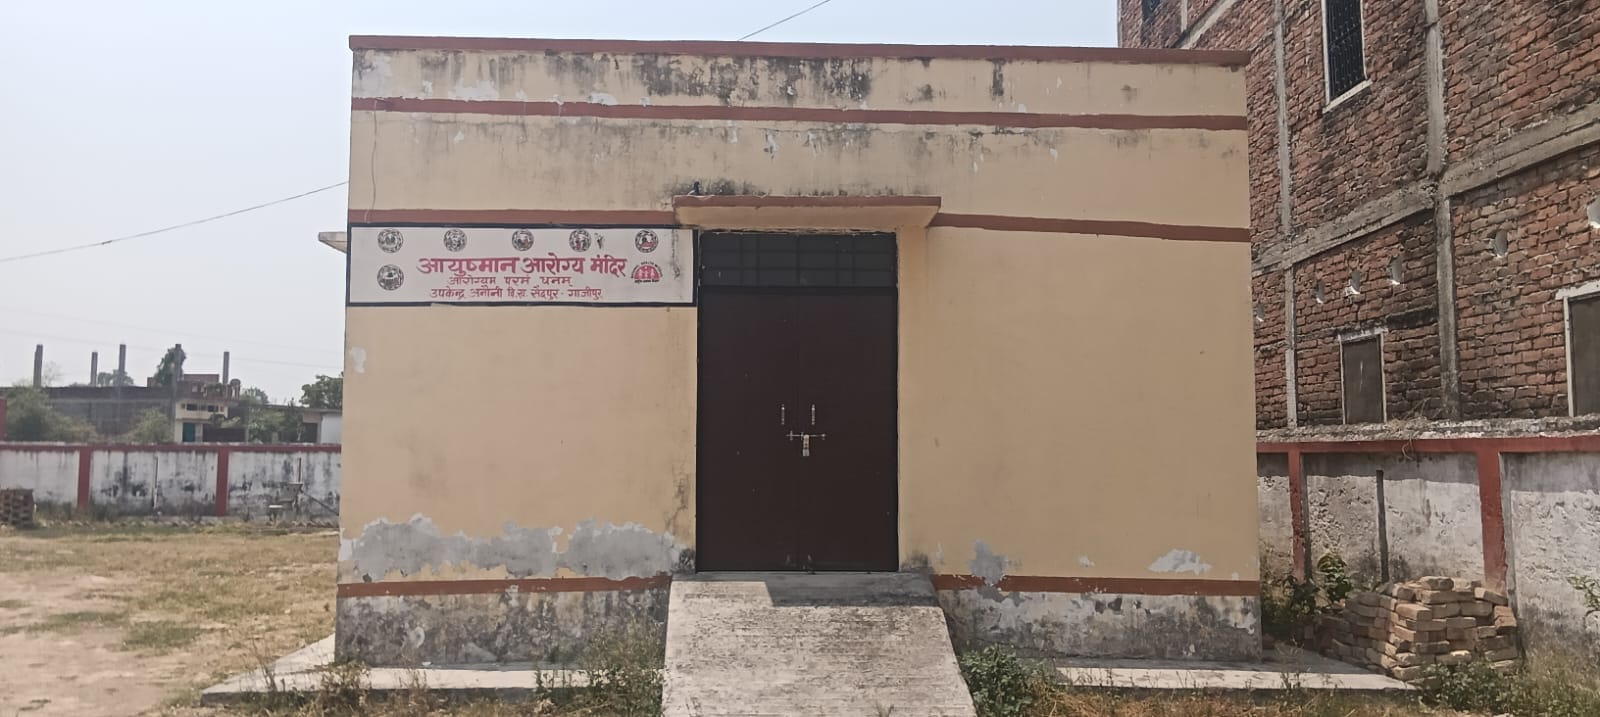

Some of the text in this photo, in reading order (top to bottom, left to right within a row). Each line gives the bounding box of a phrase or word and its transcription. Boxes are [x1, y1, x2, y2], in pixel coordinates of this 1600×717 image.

[416, 257, 520, 276] आयुष्मान
[521, 252, 586, 275] आरोग्य
[590, 254, 627, 277] मंदिर
